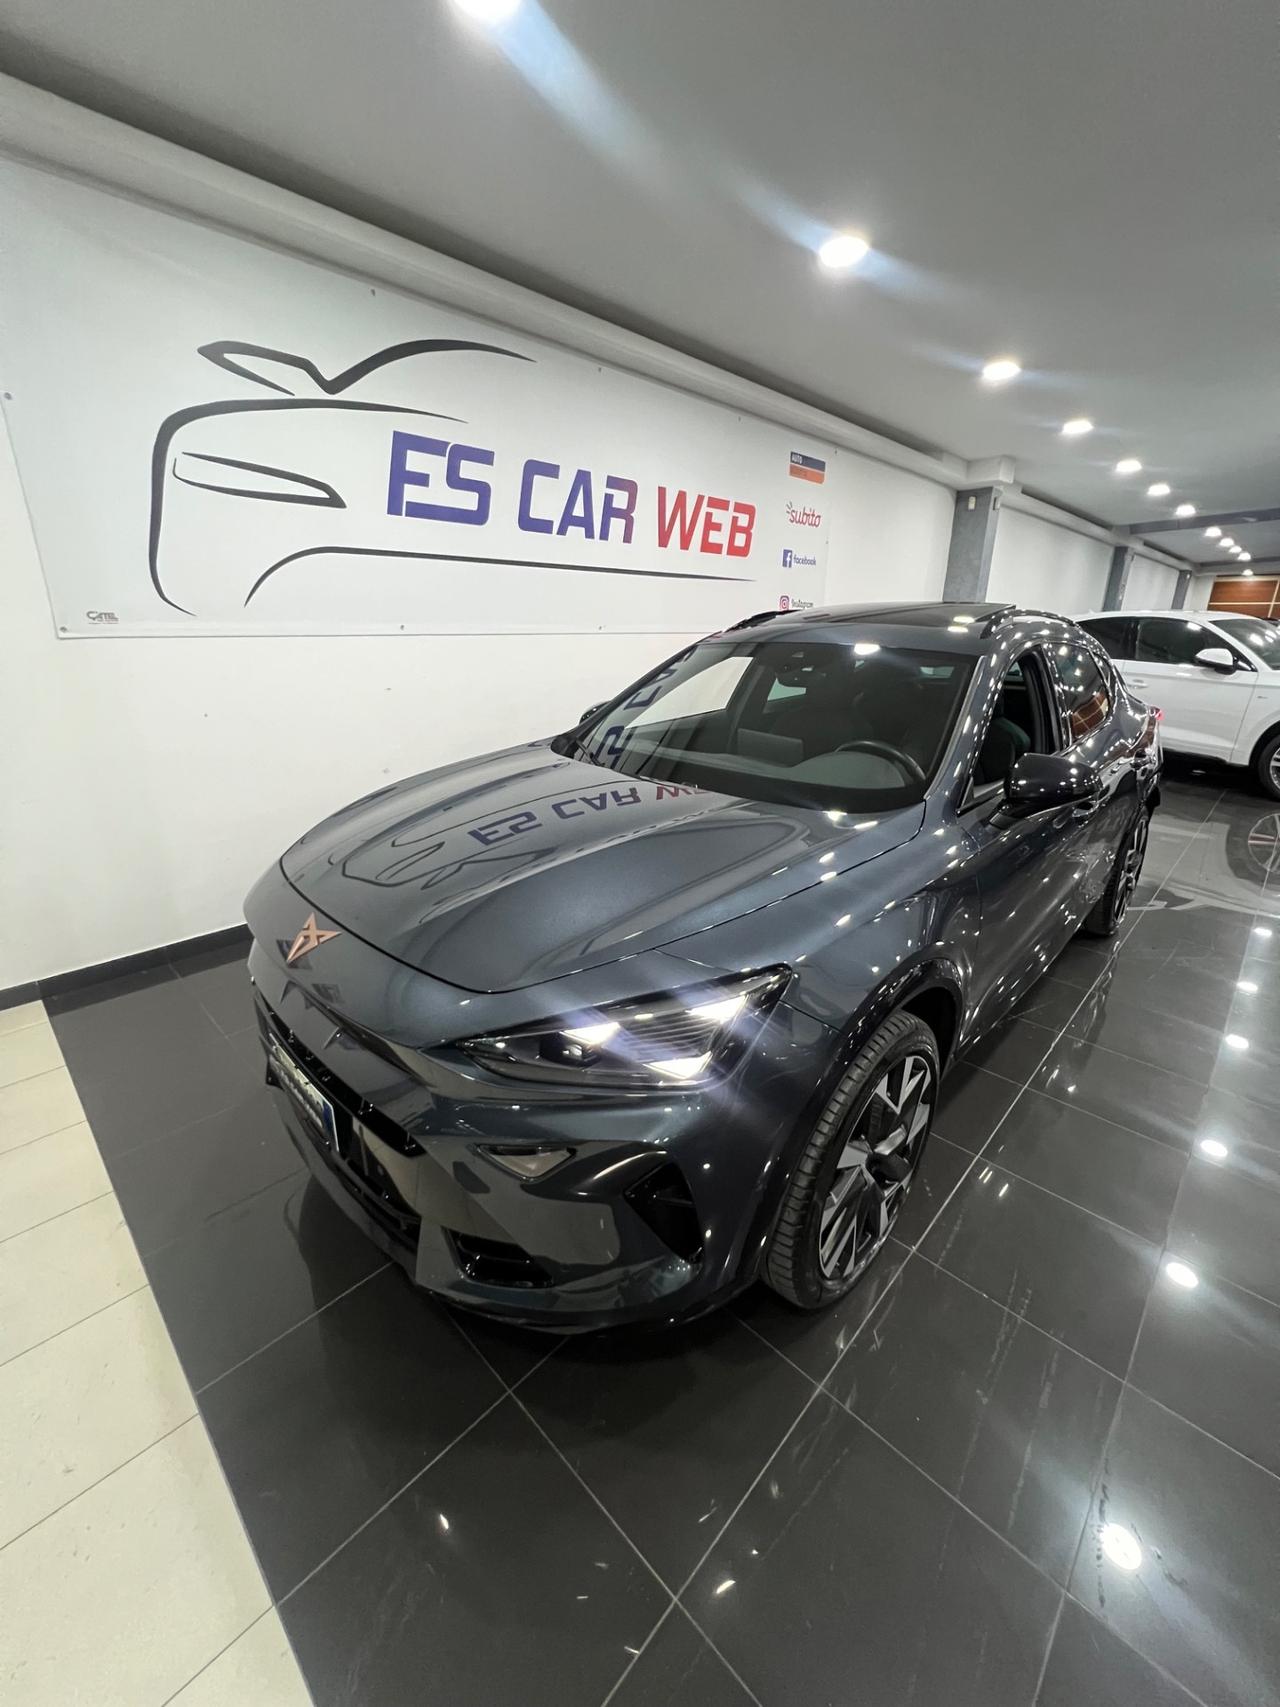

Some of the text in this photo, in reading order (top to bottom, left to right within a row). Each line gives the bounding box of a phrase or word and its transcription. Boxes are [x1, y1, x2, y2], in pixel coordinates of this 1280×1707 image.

[387, 430, 756, 557] ES CAR WEB
[789, 505, 821, 528] subito
[794, 554, 816, 566] facebook
